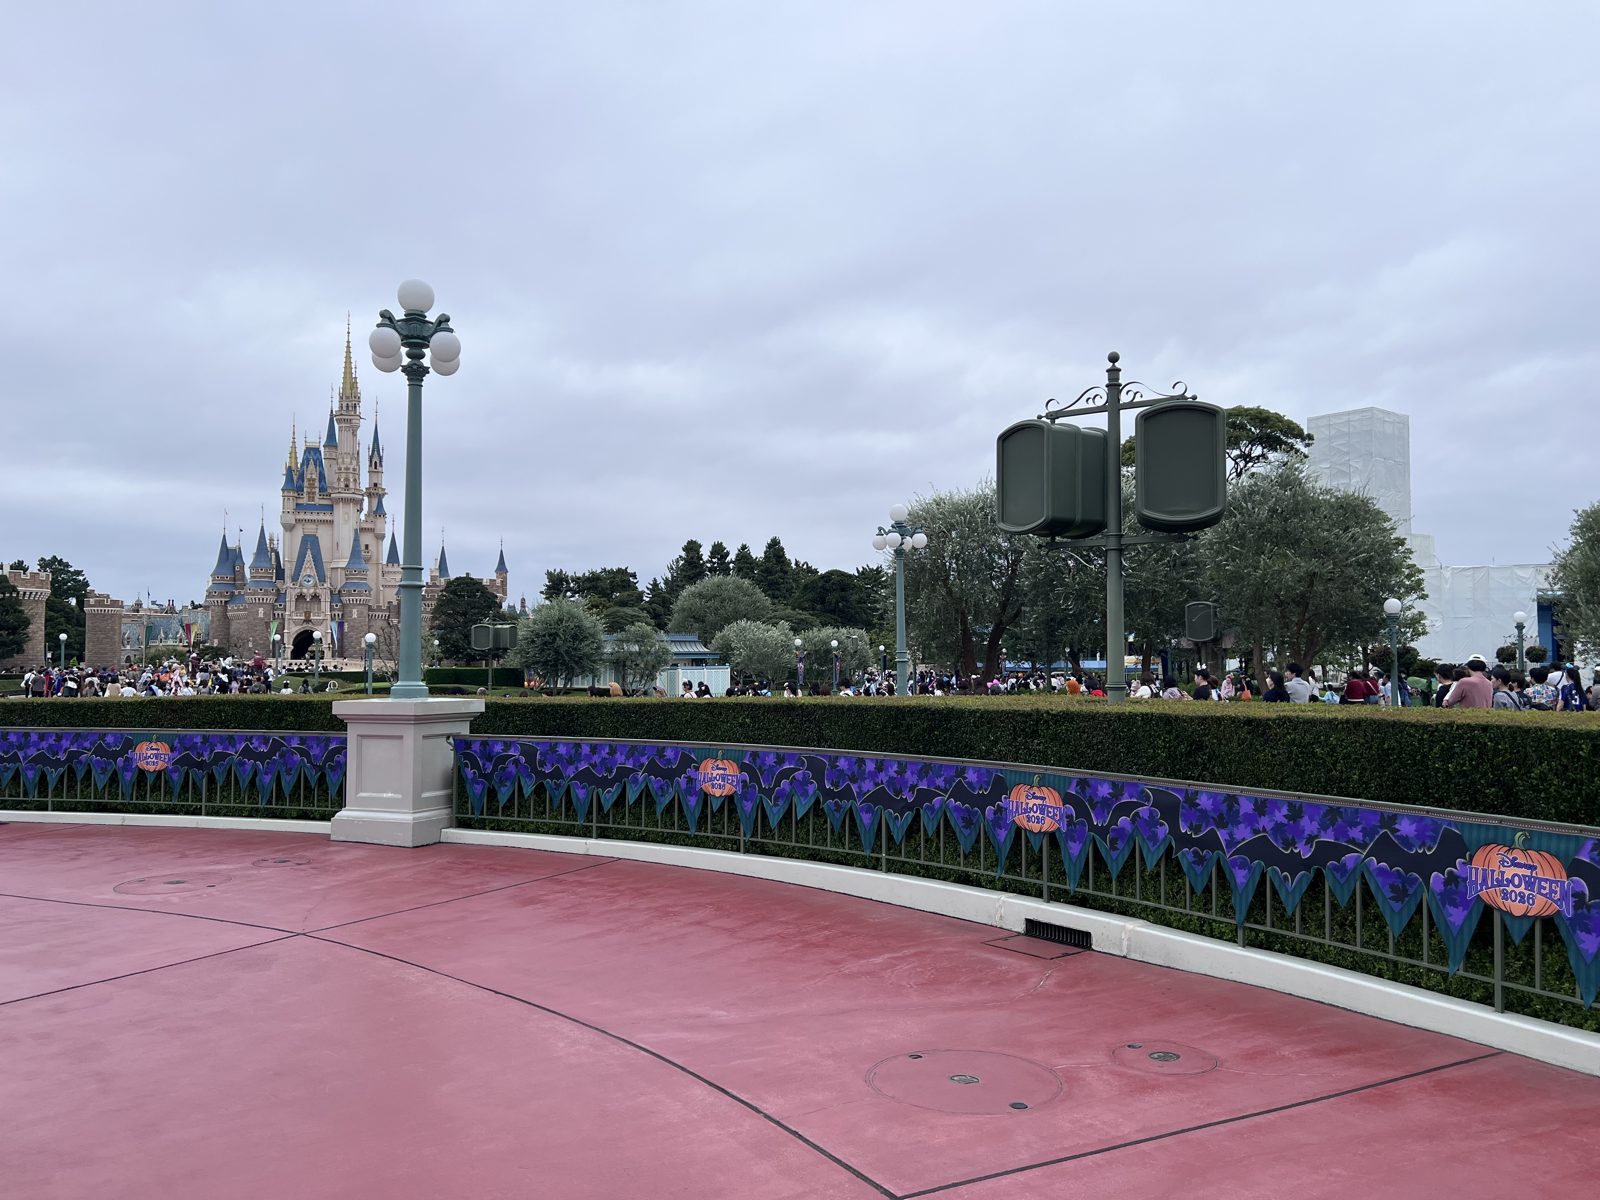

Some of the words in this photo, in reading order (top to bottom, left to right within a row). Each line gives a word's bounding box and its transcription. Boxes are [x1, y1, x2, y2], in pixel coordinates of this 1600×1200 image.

[132, 752, 173, 768] HALLOWEEN
[711, 763, 728, 773] Disney
[696, 771, 742, 795] HALLOWEEN
[1023, 789, 1047, 804] Disney
[1007, 799, 1067, 832] HALLOWEEN
[1026, 814, 1046, 826] 2026
[1496, 852, 1538, 877] Disney
[1466, 866, 1573, 918] HALLOWEEN
[1500, 887, 1537, 907] 2026
